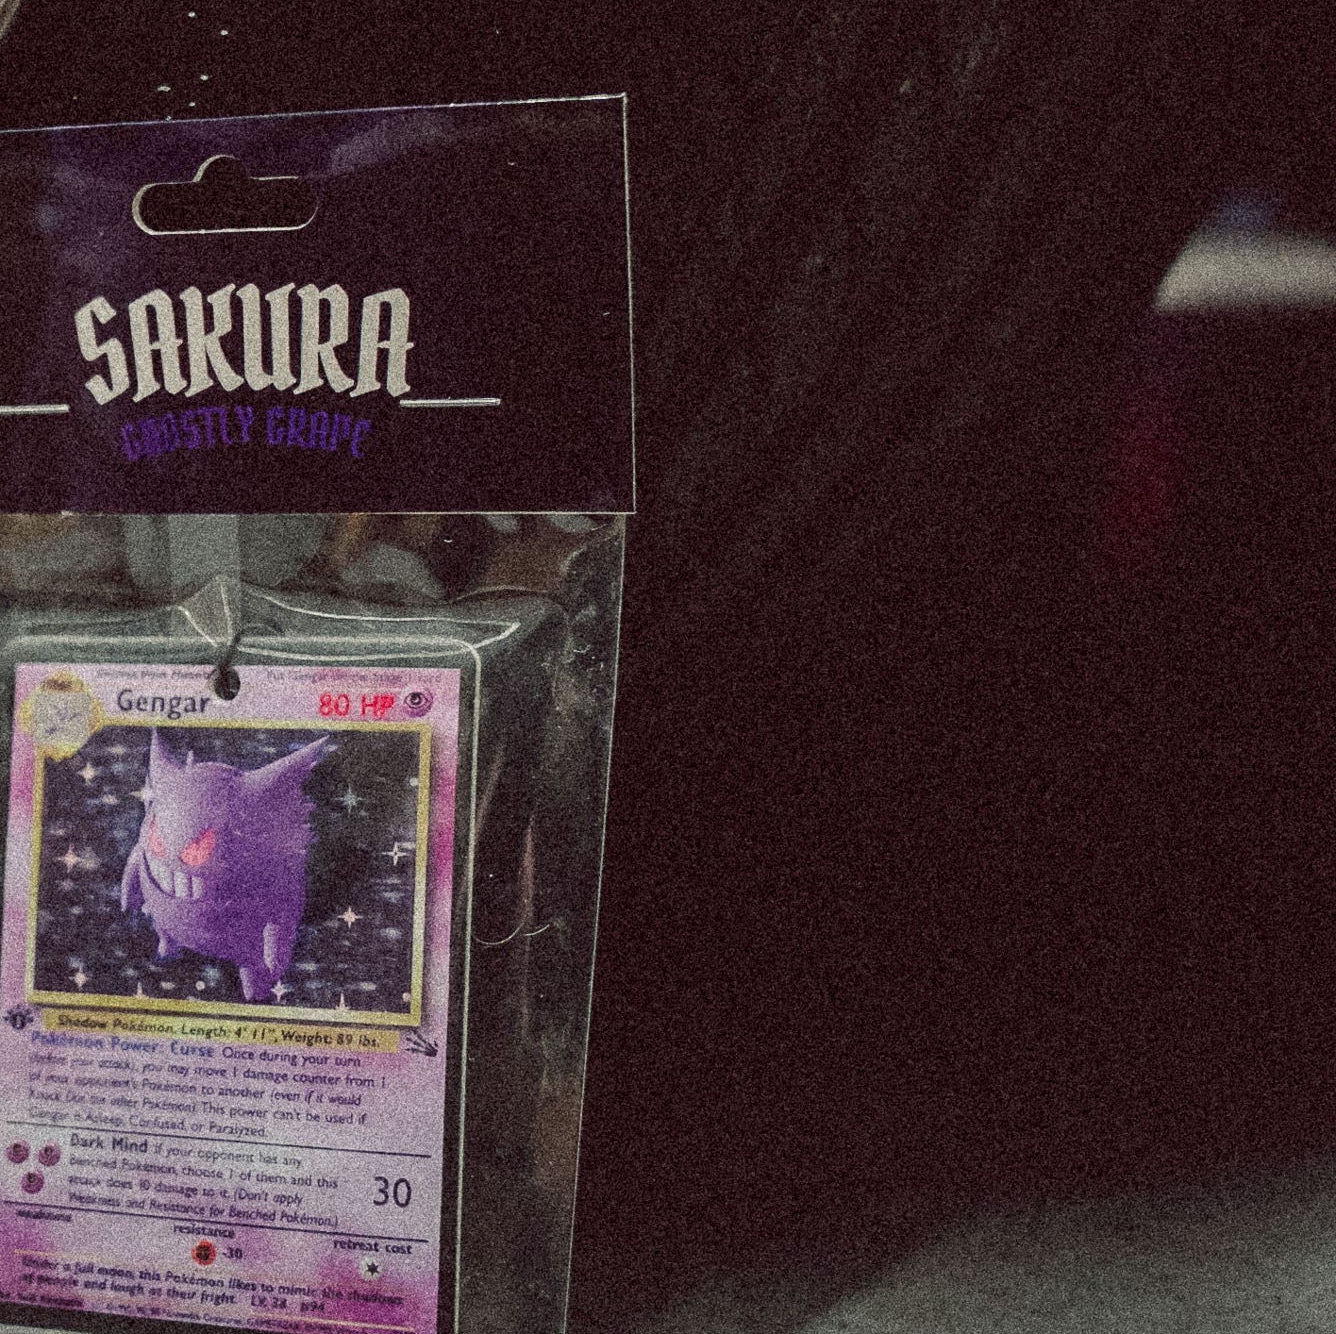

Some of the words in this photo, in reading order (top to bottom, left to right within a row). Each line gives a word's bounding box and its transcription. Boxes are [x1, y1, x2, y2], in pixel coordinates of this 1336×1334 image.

[74, 282, 414, 405] SAKURA
[121, 405, 254, 461] GHOSTLY
[266, 405, 372, 458] GRAPE
[118, 689, 214, 721] Gengar
[318, 693, 350, 718] 80
[360, 694, 395, 719] HP
[58, 1013, 107, 1030] Shadow
[181, 1024, 231, 1040] Length:
[281, 1030, 333, 1047] Weight:
[336, 1034, 354, 1046] 89
[31, 1030, 104, 1051] Pokémon
[170, 1040, 215, 1059] Curse
[221, 1046, 255, 1061] Once
[259, 1048, 298, 1067] during
[301, 1053, 329, 1068] your
[334, 1055, 361, 1067] turn
[141, 1062, 164, 1074] you
[168, 1064, 189, 1078] may
[194, 1066, 227, 1079] move
[243, 1068, 289, 1084] damage
[292, 1072, 341, 1086] counter
[345, 1075, 375, 1088] from
[142, 1078, 197, 1094] Pokémon
[201, 1085, 215, 1096] to
[218, 1086, 265, 1100] another
[328, 1094, 362, 1107] would
[111, 1096, 139, 1108] other
[201, 1101, 225, 1116] This
[229, 1107, 269, 1120] power
[272, 1109, 301, 1122] can't
[305, 1111, 321, 1123] be
[325, 1113, 355, 1125] used
[358, 1113, 369, 1125] if
[191, 1122, 204, 1133] or
[70, 1132, 105, 1149] Dark
[112, 1136, 149, 1154] Mind
[166, 1147, 193, 1159] your
[197, 1148, 253, 1165] opponent
[259, 1153, 278, 1166] has
[282, 1156, 303, 1169] any
[182, 1165, 224, 1179] choose
[239, 1170, 252, 1182] of
[255, 1173, 288, 1185] them
[291, 1175, 312, 1187] and
[317, 1177, 338, 1189] this
[154, 1181, 198, 1198] damage
[273, 1193, 303, 1207] apply
[372, 1175, 413, 1209] 30
[125, 1198, 145, 1210] and
[149, 1198, 205, 1215] Resistance
[208, 1205, 225, 1219] for
[228, 1205, 276, 1222] Benched
[173, 1222, 236, 1240] resistance
[332, 1238, 380, 1253] retreat
[384, 1243, 413, 1256] cost
[83, 1277, 107, 1290] and
[110, 1281, 144, 1297] laugh
[166, 1286, 197, 1300] their
[139, 1269, 161, 1282] this
[165, 1270, 224, 1288] Pokémon
[228, 1278, 257, 1292] likes
[260, 1281, 275, 1294] to
[322, 1285, 344, 1300] the
